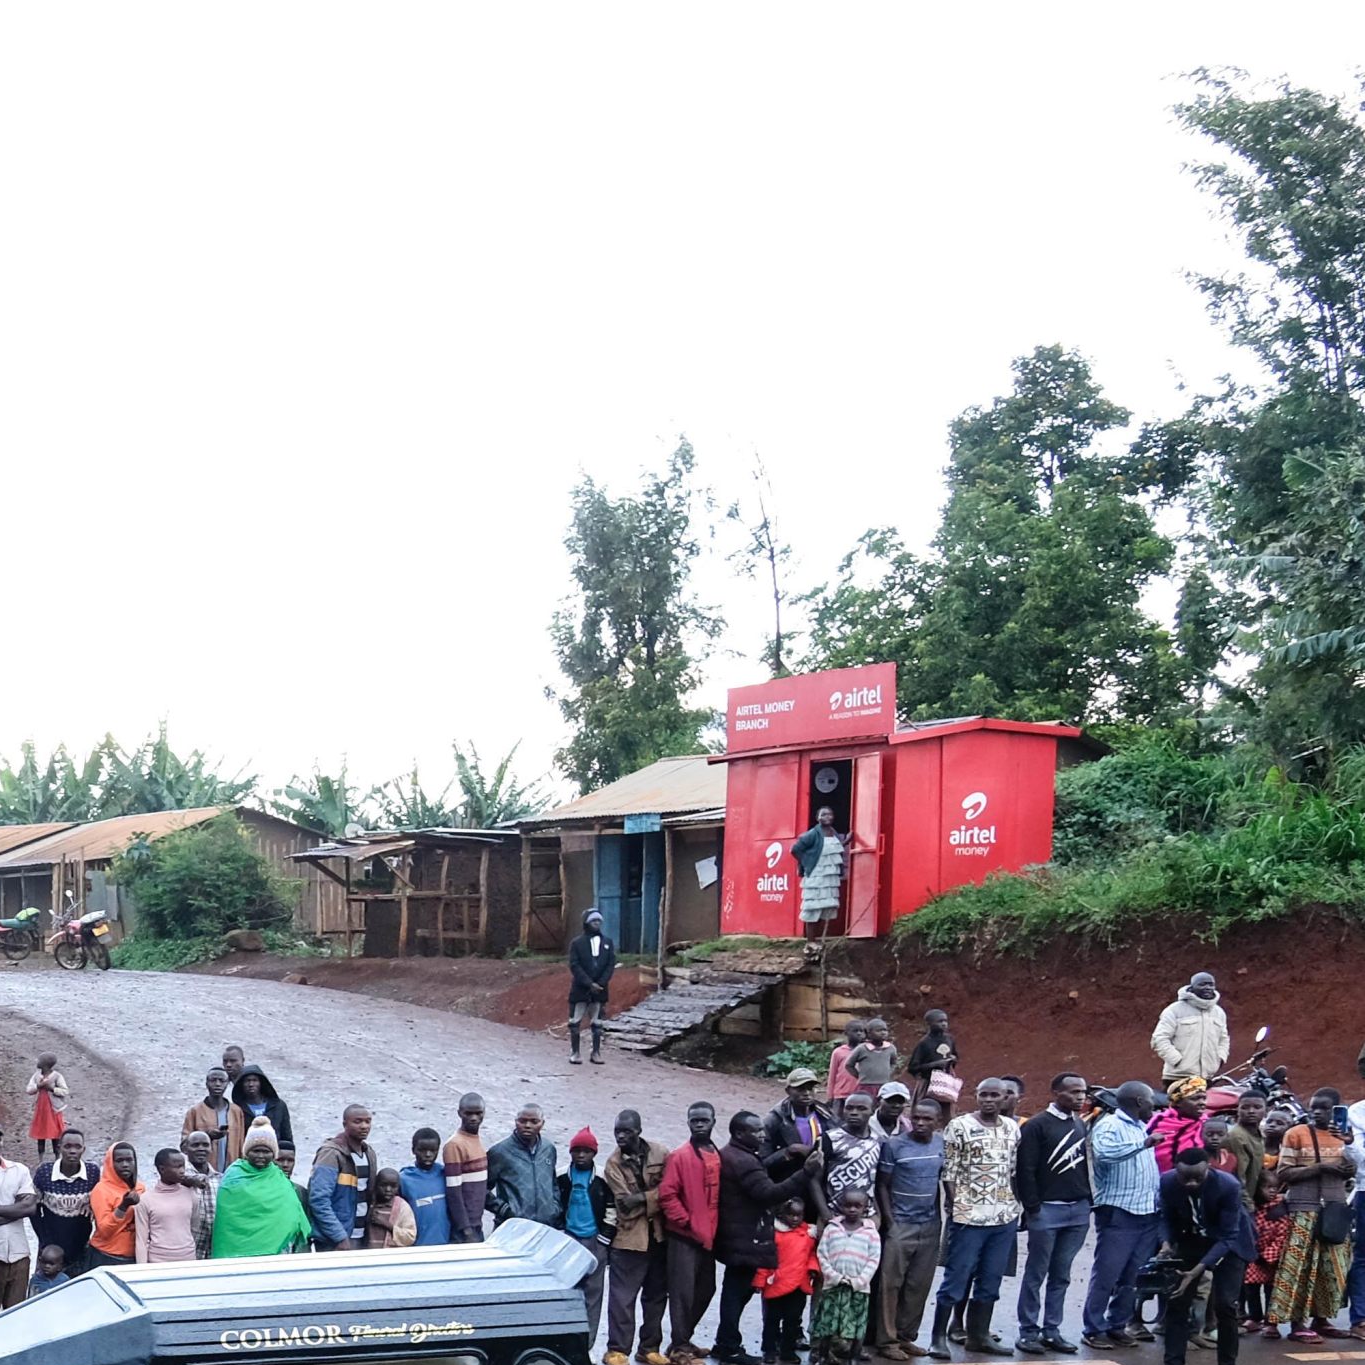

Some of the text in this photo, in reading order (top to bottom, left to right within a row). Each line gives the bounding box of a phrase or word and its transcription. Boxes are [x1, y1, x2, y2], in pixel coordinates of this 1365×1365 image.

[844, 684, 882, 708] airtel
[736, 700, 795, 717] AIRTEL MONEY
[735, 718, 769, 731] BRANCH
[949, 825, 997, 845] airtel
[954, 845, 990, 858] money
[756, 873, 789, 892] airtel
[760, 892, 785, 904] money
[220, 1320, 476, 1350] COLMOR Funeral Directors
